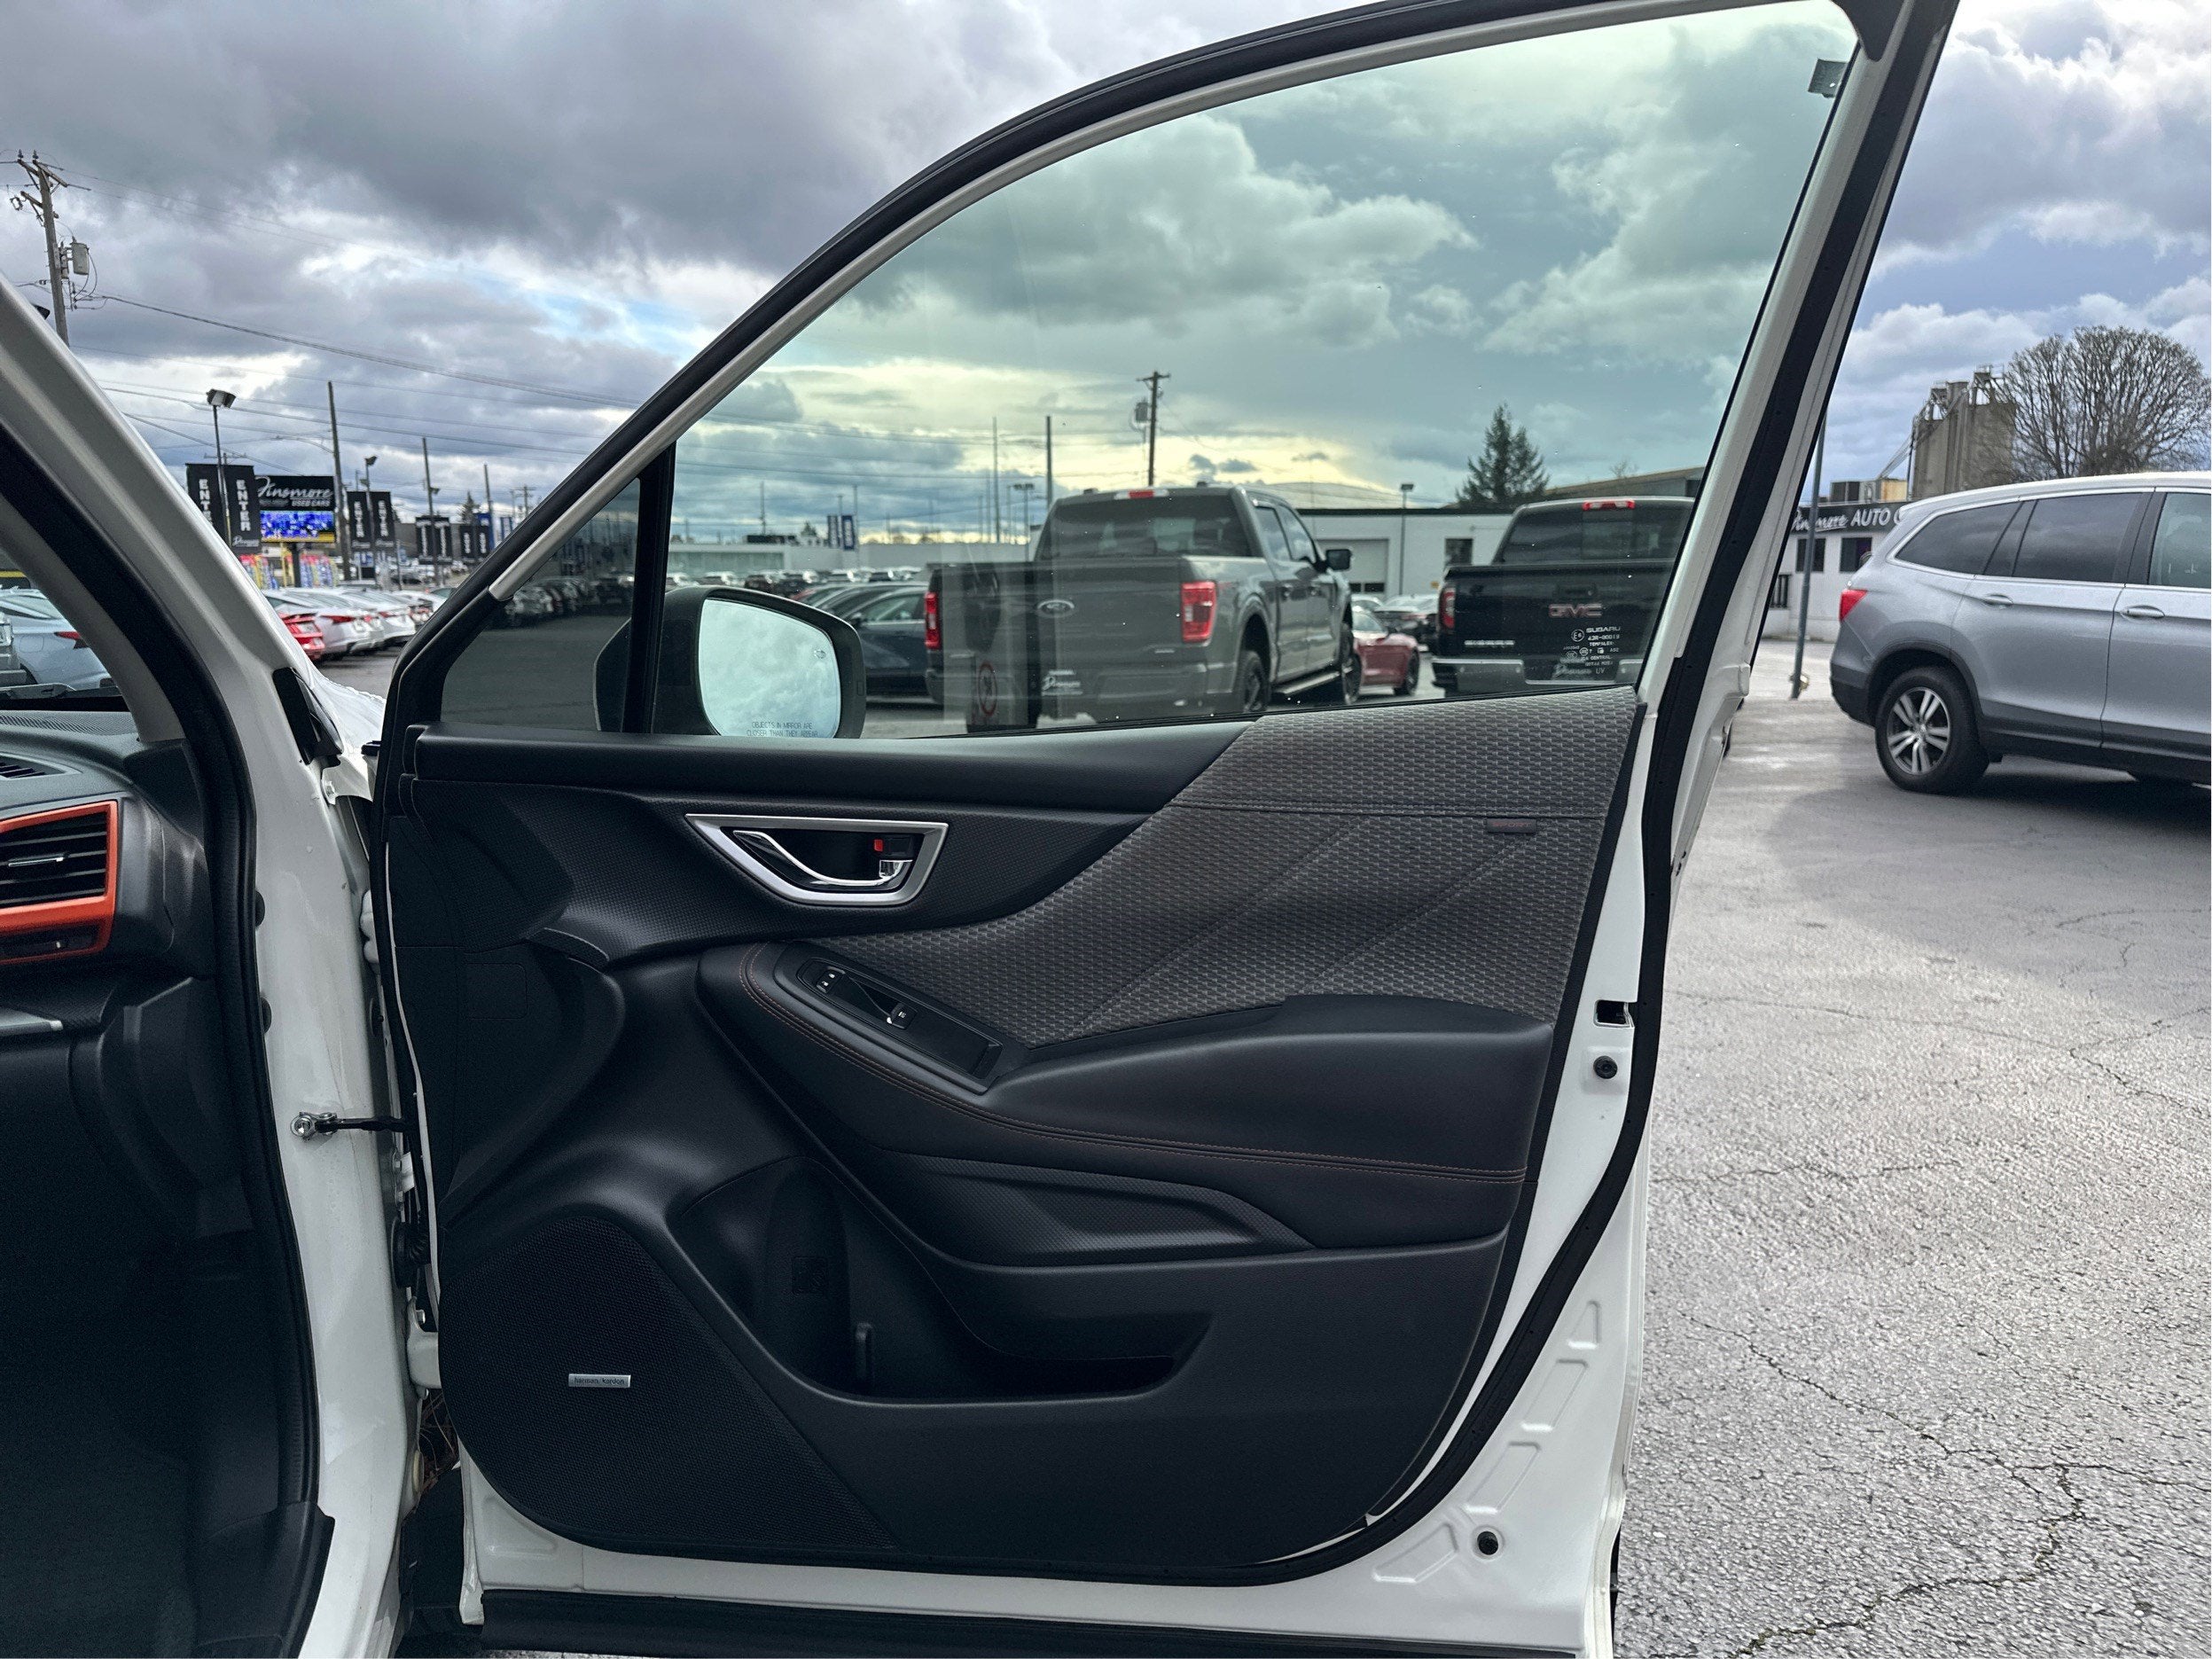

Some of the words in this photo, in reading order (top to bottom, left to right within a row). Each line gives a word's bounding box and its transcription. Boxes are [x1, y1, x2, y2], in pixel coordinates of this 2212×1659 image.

[199, 479, 213, 525] ENTE
[236, 479, 251, 532] ENTER
[1850, 507, 1891, 527] AUTO
[1549, 604, 1602, 618] GMC
